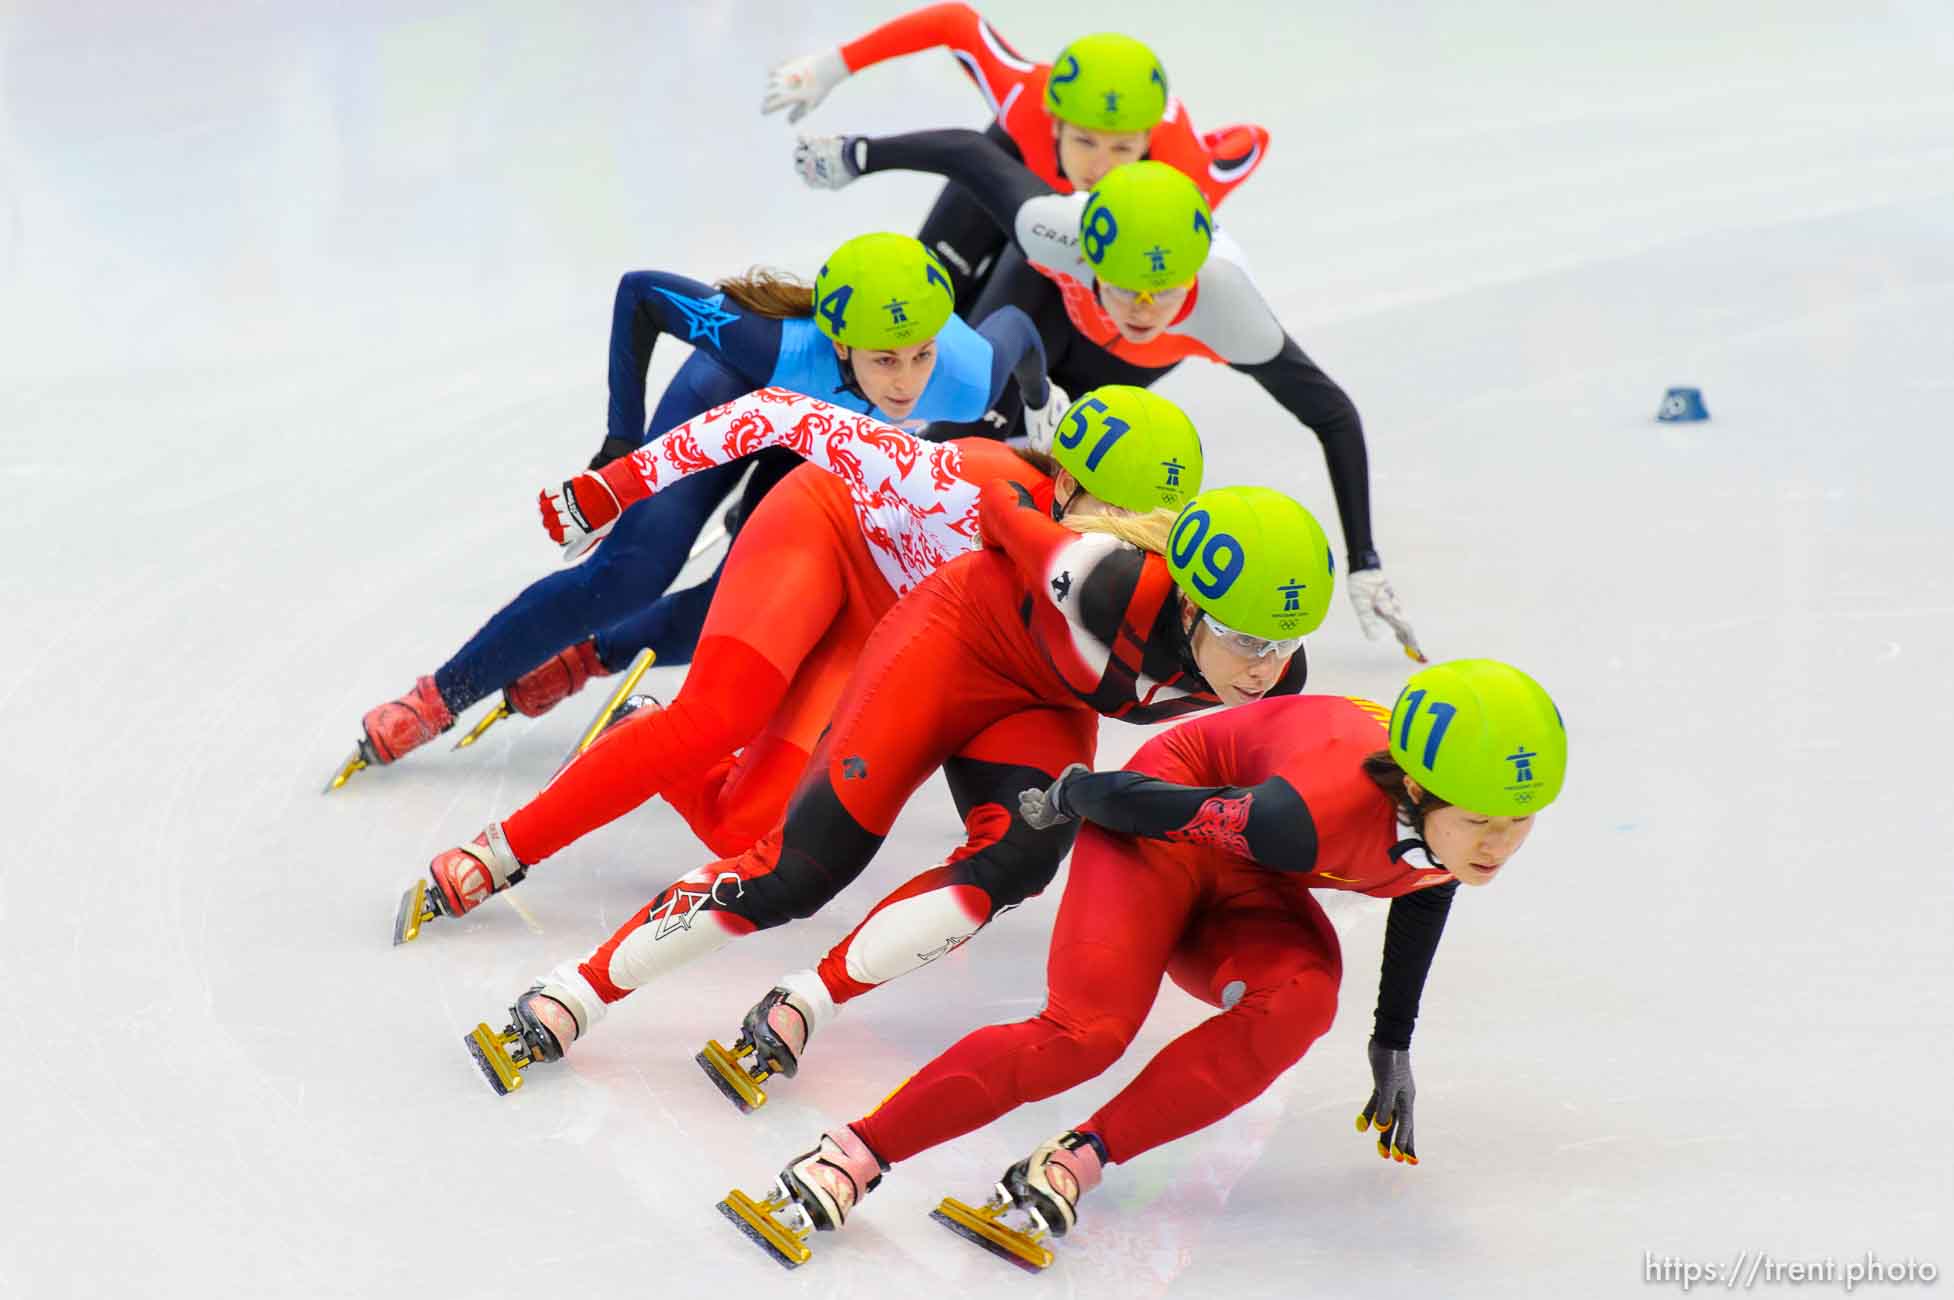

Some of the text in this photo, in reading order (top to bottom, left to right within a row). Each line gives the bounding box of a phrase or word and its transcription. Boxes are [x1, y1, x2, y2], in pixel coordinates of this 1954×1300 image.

[1081, 192, 1117, 264] 8
[1169, 501, 1245, 599] 09
[1390, 684, 1457, 772] 11
[649, 872, 745, 941] CAN
